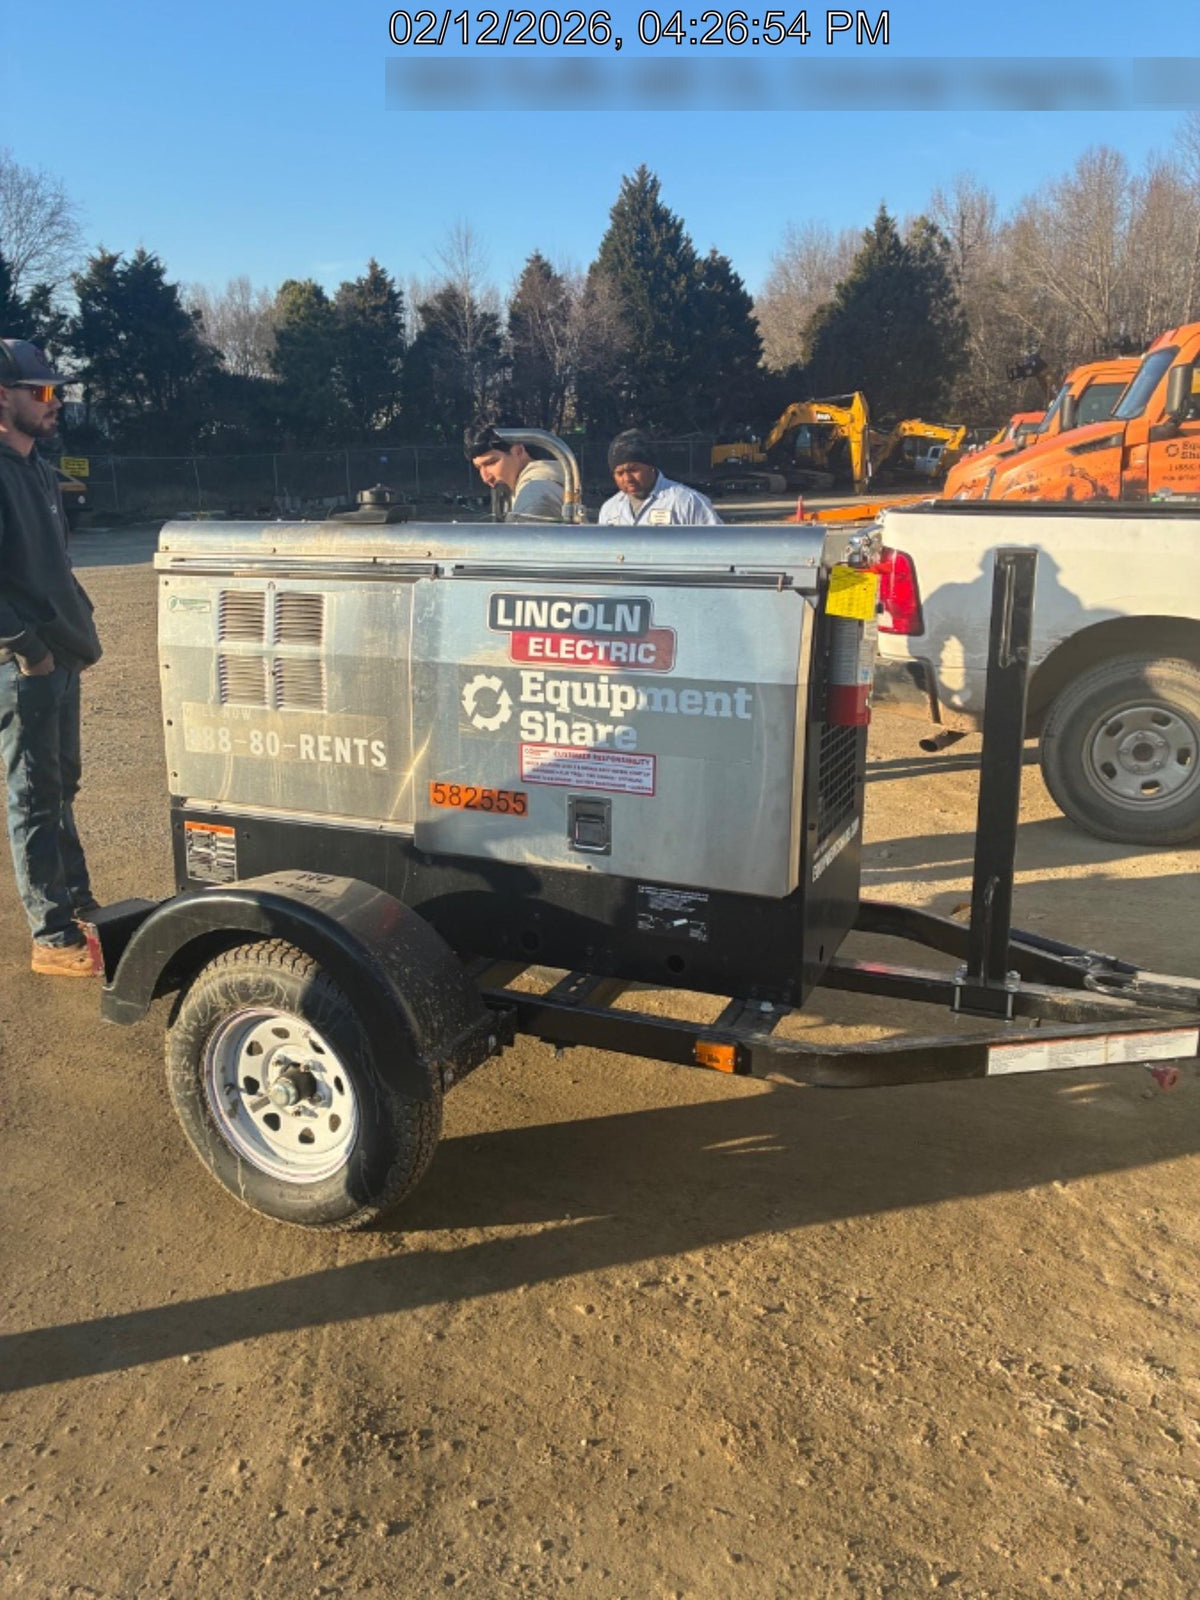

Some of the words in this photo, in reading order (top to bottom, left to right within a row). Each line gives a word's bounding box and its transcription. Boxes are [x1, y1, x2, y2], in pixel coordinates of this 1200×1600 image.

[496, 598, 641, 632] LINCOLN
[528, 636, 656, 664] ELECTRIC
[519, 670, 753, 720] Equipment
[519, 710, 638, 750] Share
[433, 783, 527, 815] 582555
